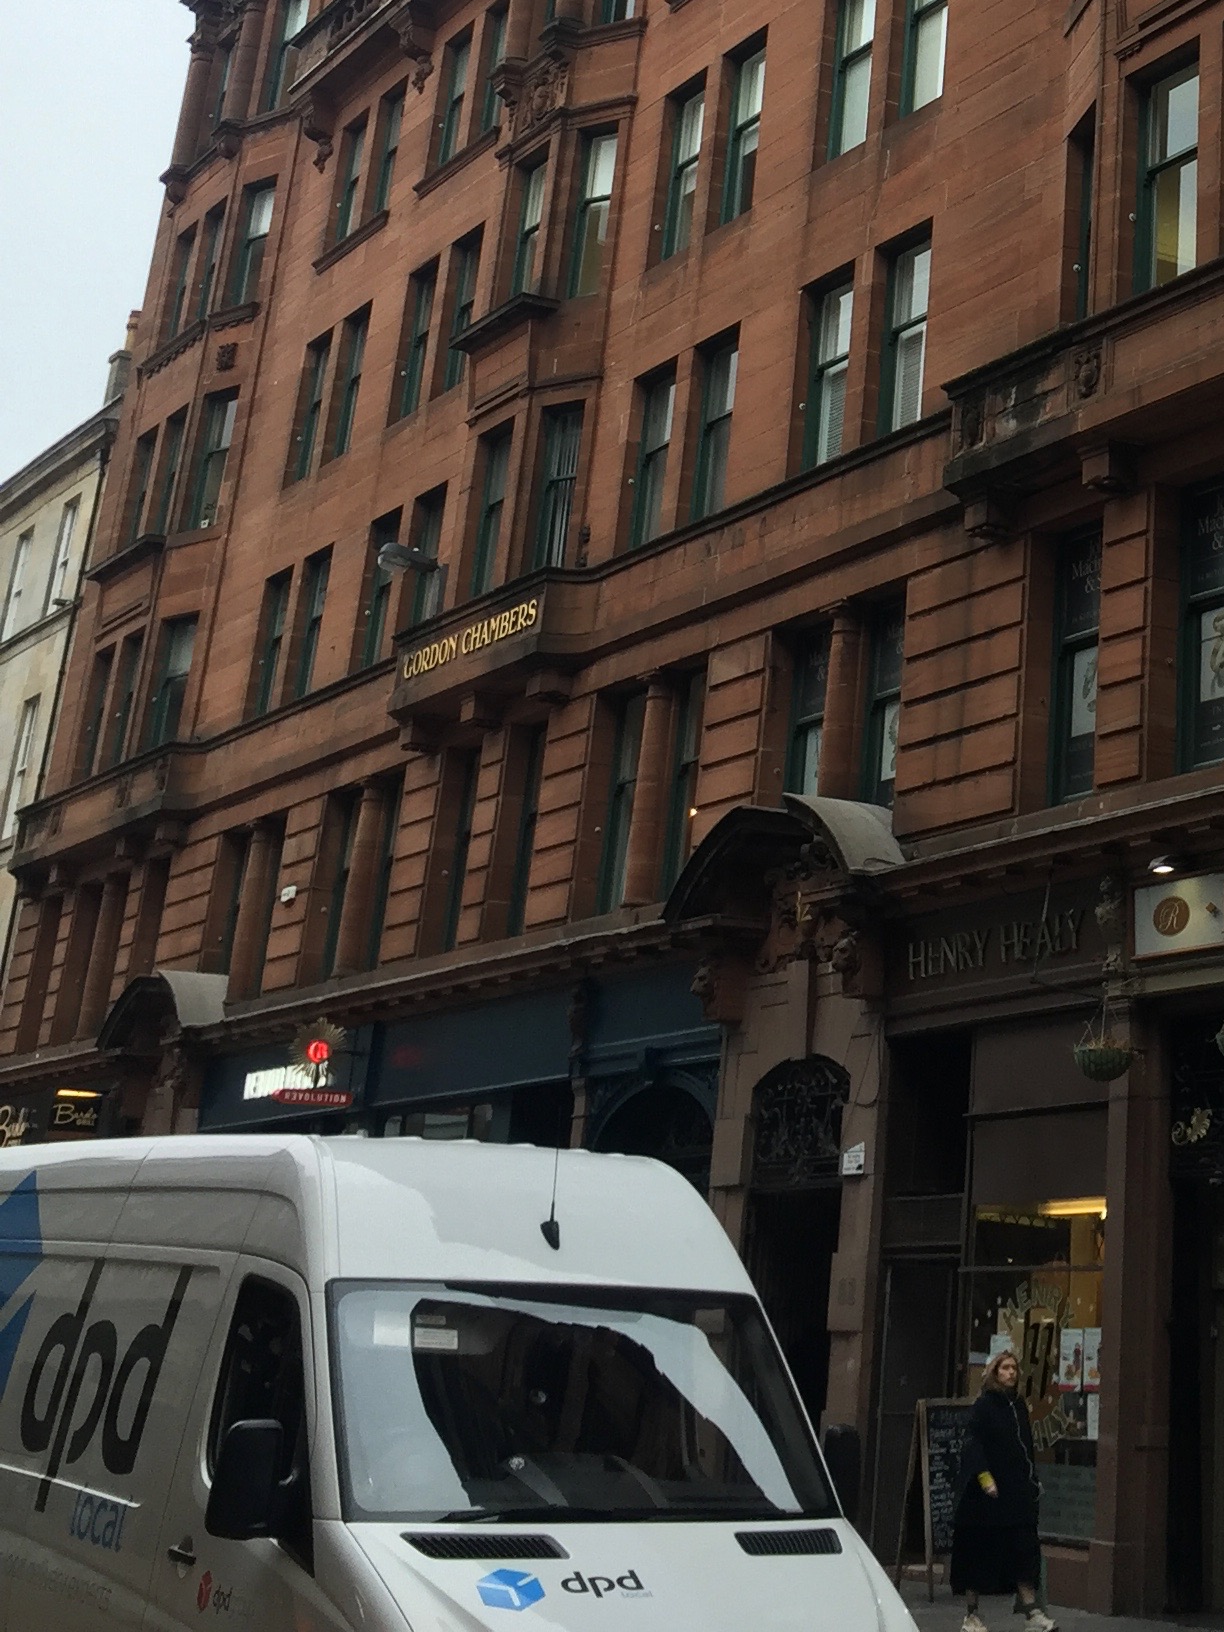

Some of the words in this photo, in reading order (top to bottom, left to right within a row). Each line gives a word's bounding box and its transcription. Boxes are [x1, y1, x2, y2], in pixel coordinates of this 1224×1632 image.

[403, 632, 459, 680] GORDON
[461, 598, 538, 655] CHAMBERS
[908, 926, 992, 981] HENRY
[1000, 908, 1086, 963] HEALY
[1003, 1280, 1075, 1332] HENRY
[20, 1257, 193, 1513] dpd
[69, 1484, 133, 1553] local
[560, 1569, 645, 1599] dpd
